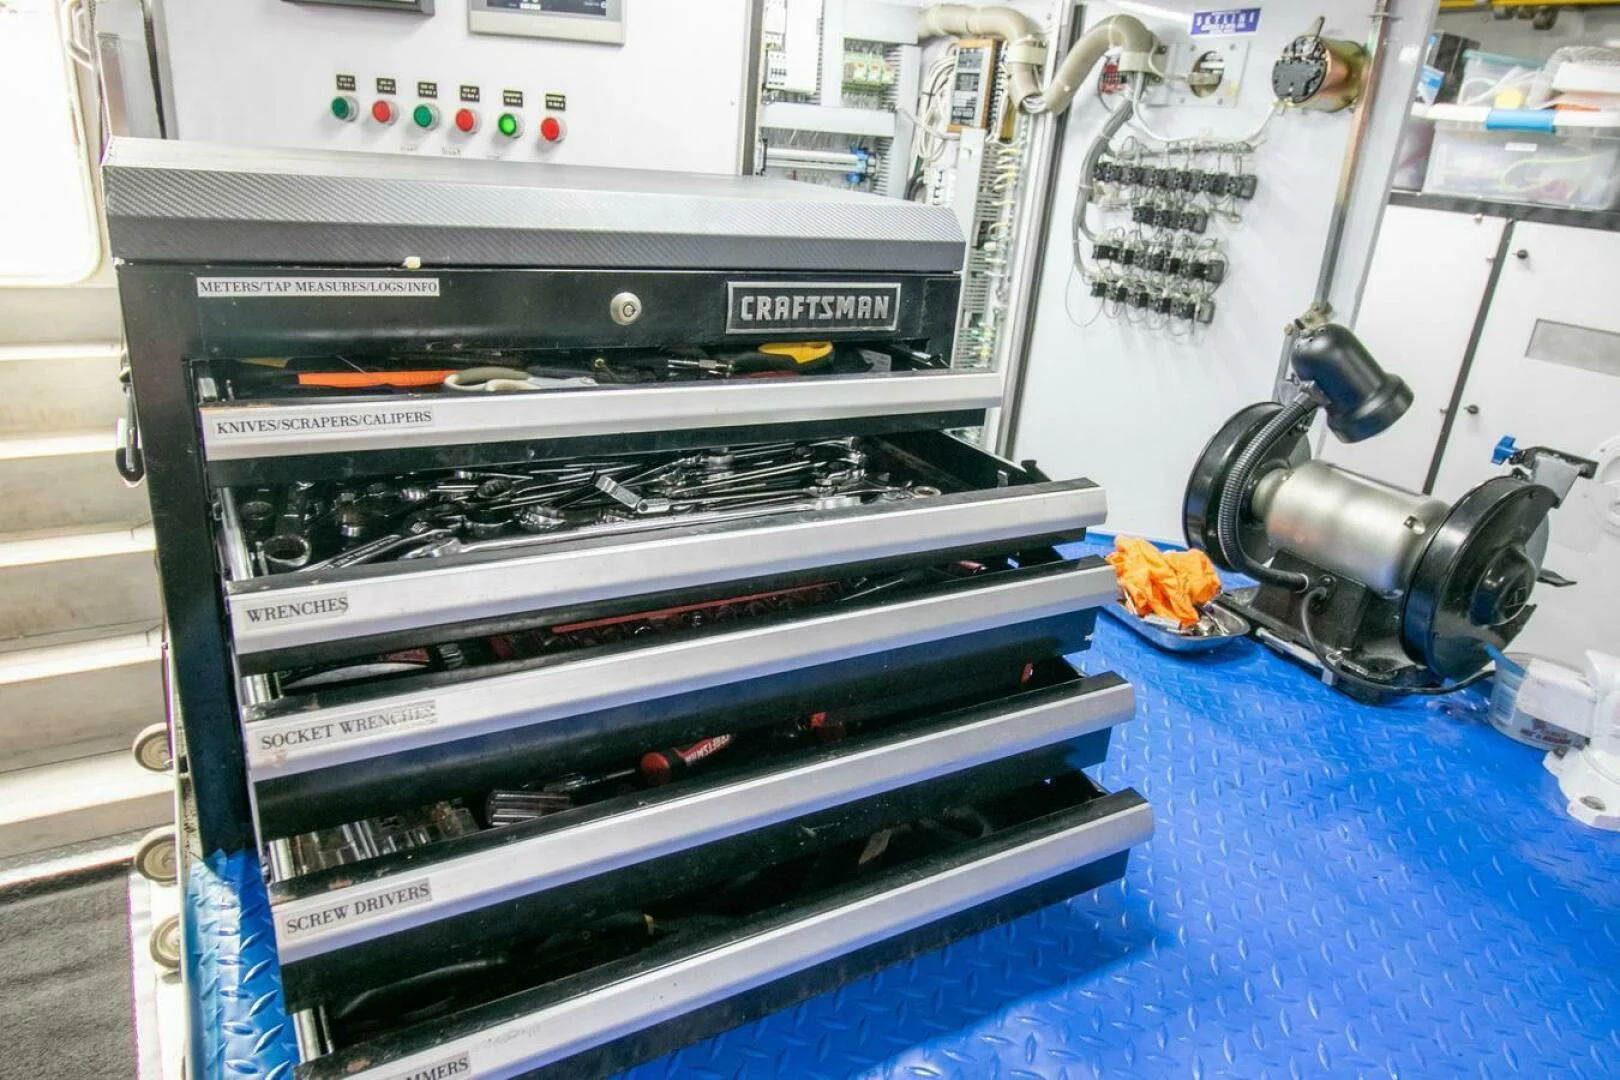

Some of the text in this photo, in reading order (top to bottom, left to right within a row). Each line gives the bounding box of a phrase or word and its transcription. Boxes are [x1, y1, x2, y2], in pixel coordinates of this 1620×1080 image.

[199, 280, 437, 294] METERS/TAP MEASURES/LOGS/INFO
[740, 295, 889, 321] CRAFTSMAN
[216, 410, 432, 434] KNIVES/SCRAPERS/CALIPERS
[246, 596, 349, 622] WRENCHES
[261, 723, 335, 750] SOCKET
[286, 882, 430, 934] SCREW DRIVERS
